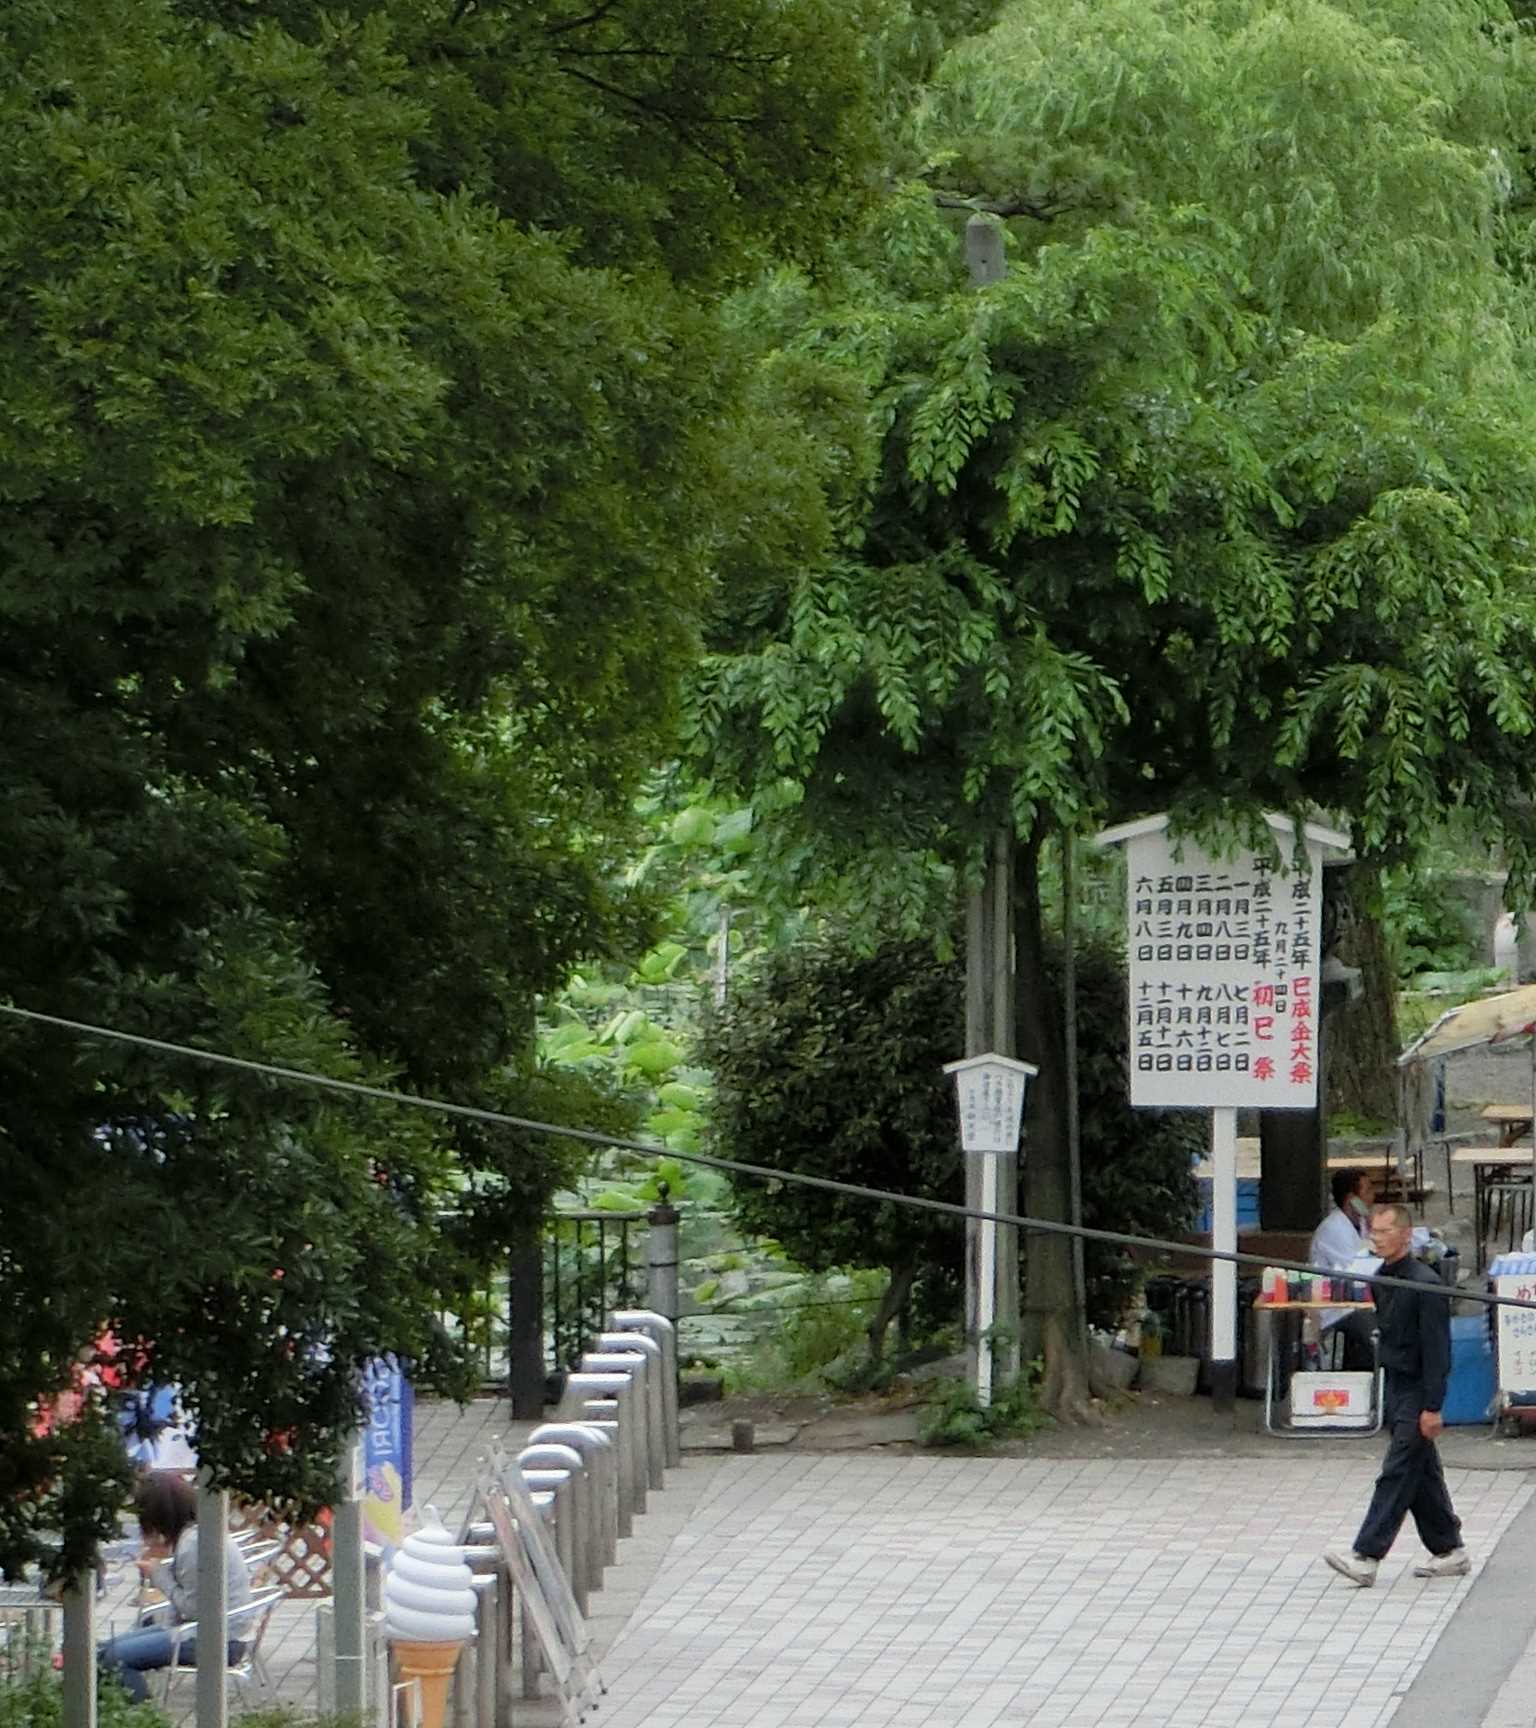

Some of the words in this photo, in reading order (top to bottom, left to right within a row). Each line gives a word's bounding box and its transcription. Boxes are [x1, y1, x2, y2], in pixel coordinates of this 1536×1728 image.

[1135, 875, 1153, 961] 六月八日
[1157, 875, 1174, 961] 五月三日
[1175, 875, 1193, 961] 四月九日
[1195, 874, 1214, 961] 三月四日
[1214, 874, 1233, 961] 二月八日
[1233, 881, 1251, 960] 一月三日
[1252, 856, 1273, 969] 平成二十五年
[1274, 921, 1289, 1013] 九月二十四日
[1175, 981, 1193, 1071] 十月六日
[1233, 984, 1251, 1071] 七月二日
